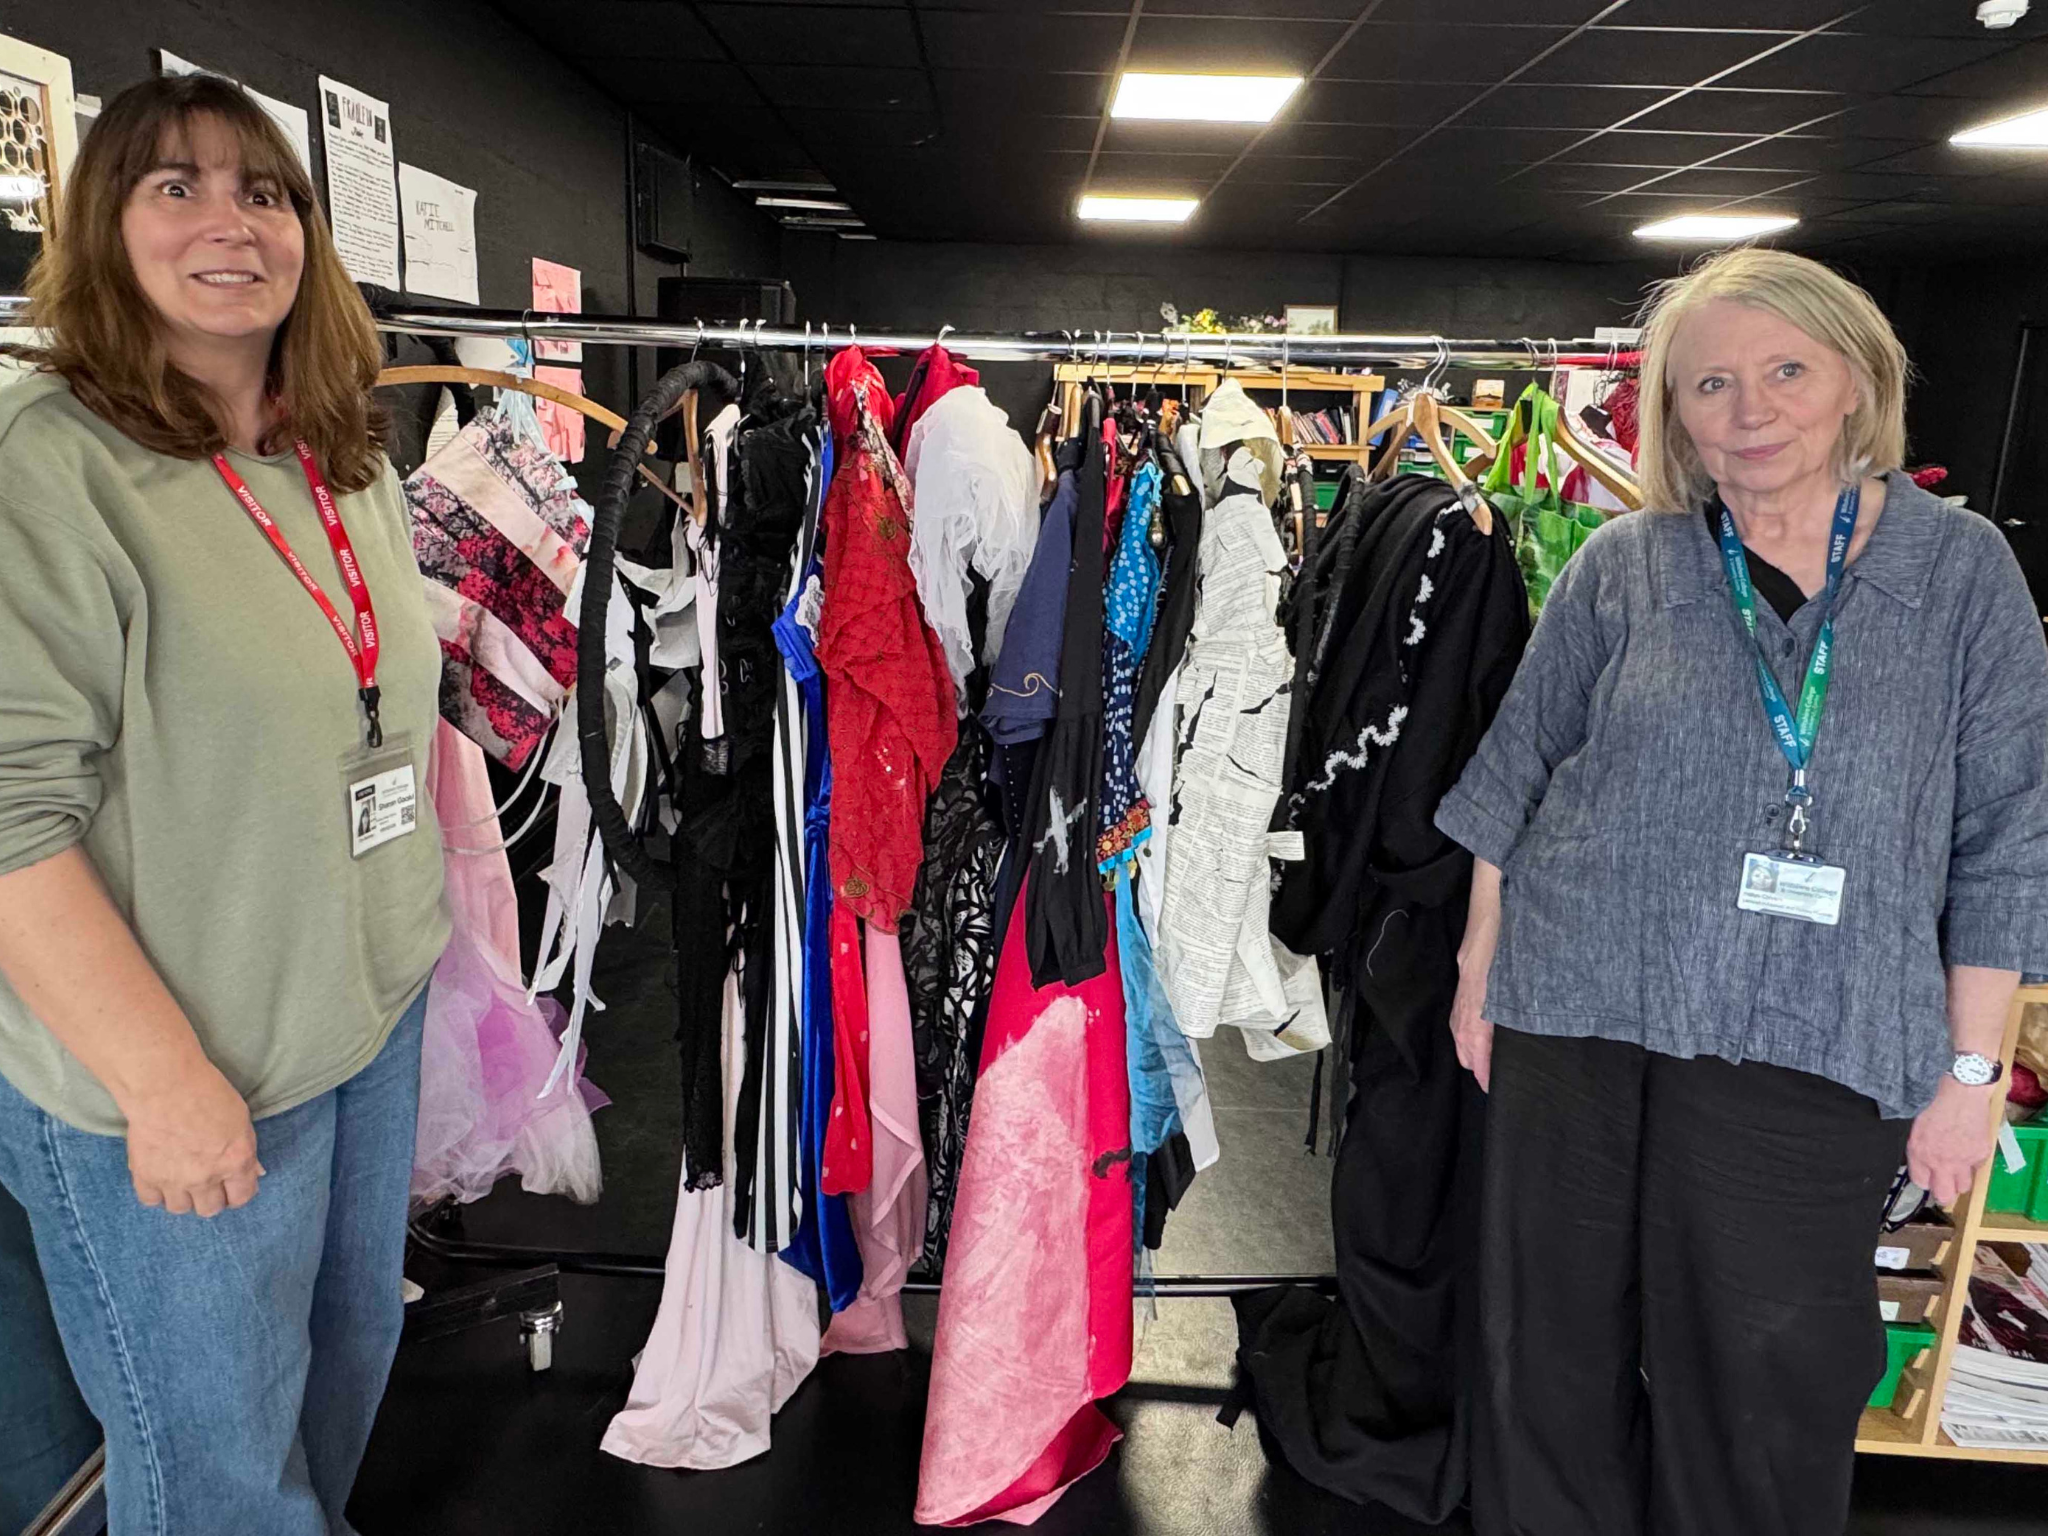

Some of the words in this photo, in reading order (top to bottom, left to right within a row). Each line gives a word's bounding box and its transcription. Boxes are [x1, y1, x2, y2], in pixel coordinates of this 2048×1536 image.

[237, 485, 273, 527] VISITOR
[315, 485, 337, 527] VISITOR
[1720, 511, 1734, 538] STAFF
[1830, 533, 1846, 563] STAFF
[288, 551, 319, 592] VISITOR
[339, 549, 361, 588] VISITOR
[332, 614, 359, 658] VISITOR
[360, 611, 376, 649] VISITOR
[1813, 640, 1829, 675] STAFF
[1773, 713, 1797, 748] STAFF
